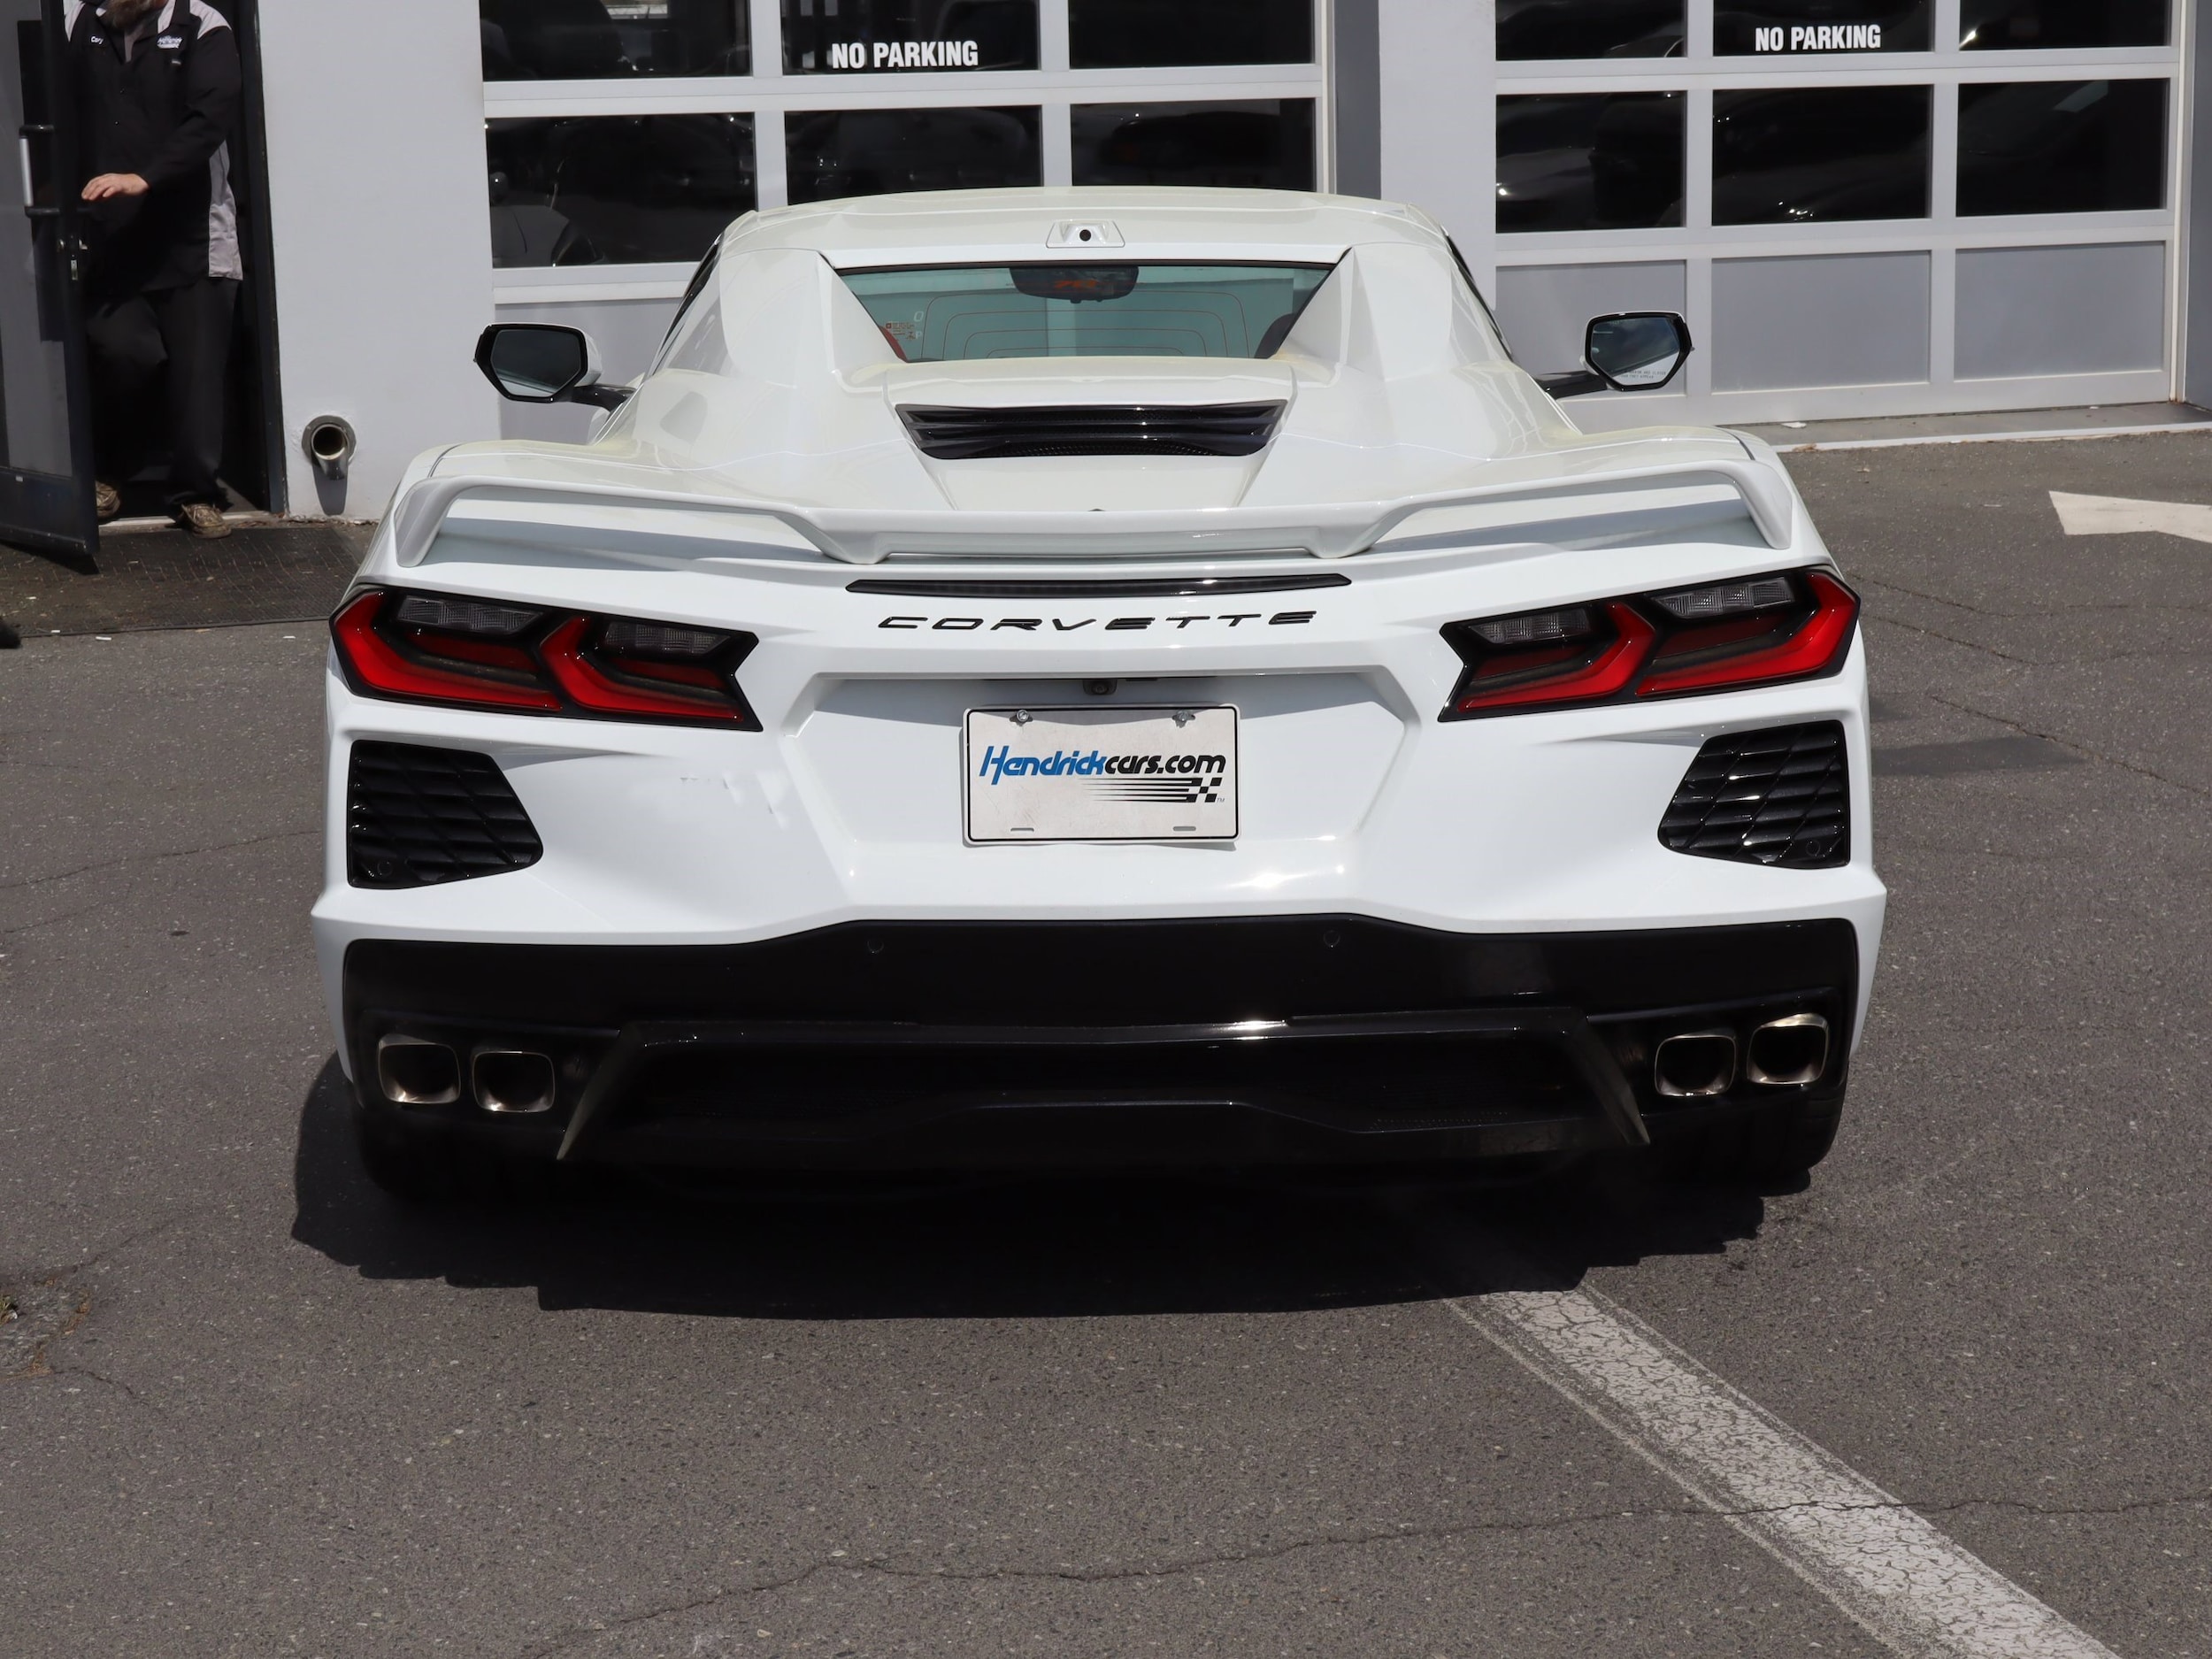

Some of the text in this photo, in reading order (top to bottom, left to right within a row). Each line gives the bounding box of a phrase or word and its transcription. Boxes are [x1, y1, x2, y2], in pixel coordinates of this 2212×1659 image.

[1755, 24, 1881, 51] NO PARKING
[832, 40, 979, 69] NO PARKING
[878, 611, 1317, 631] CORVETTE
[979, 745, 1226, 785] Hendrickcars.com
